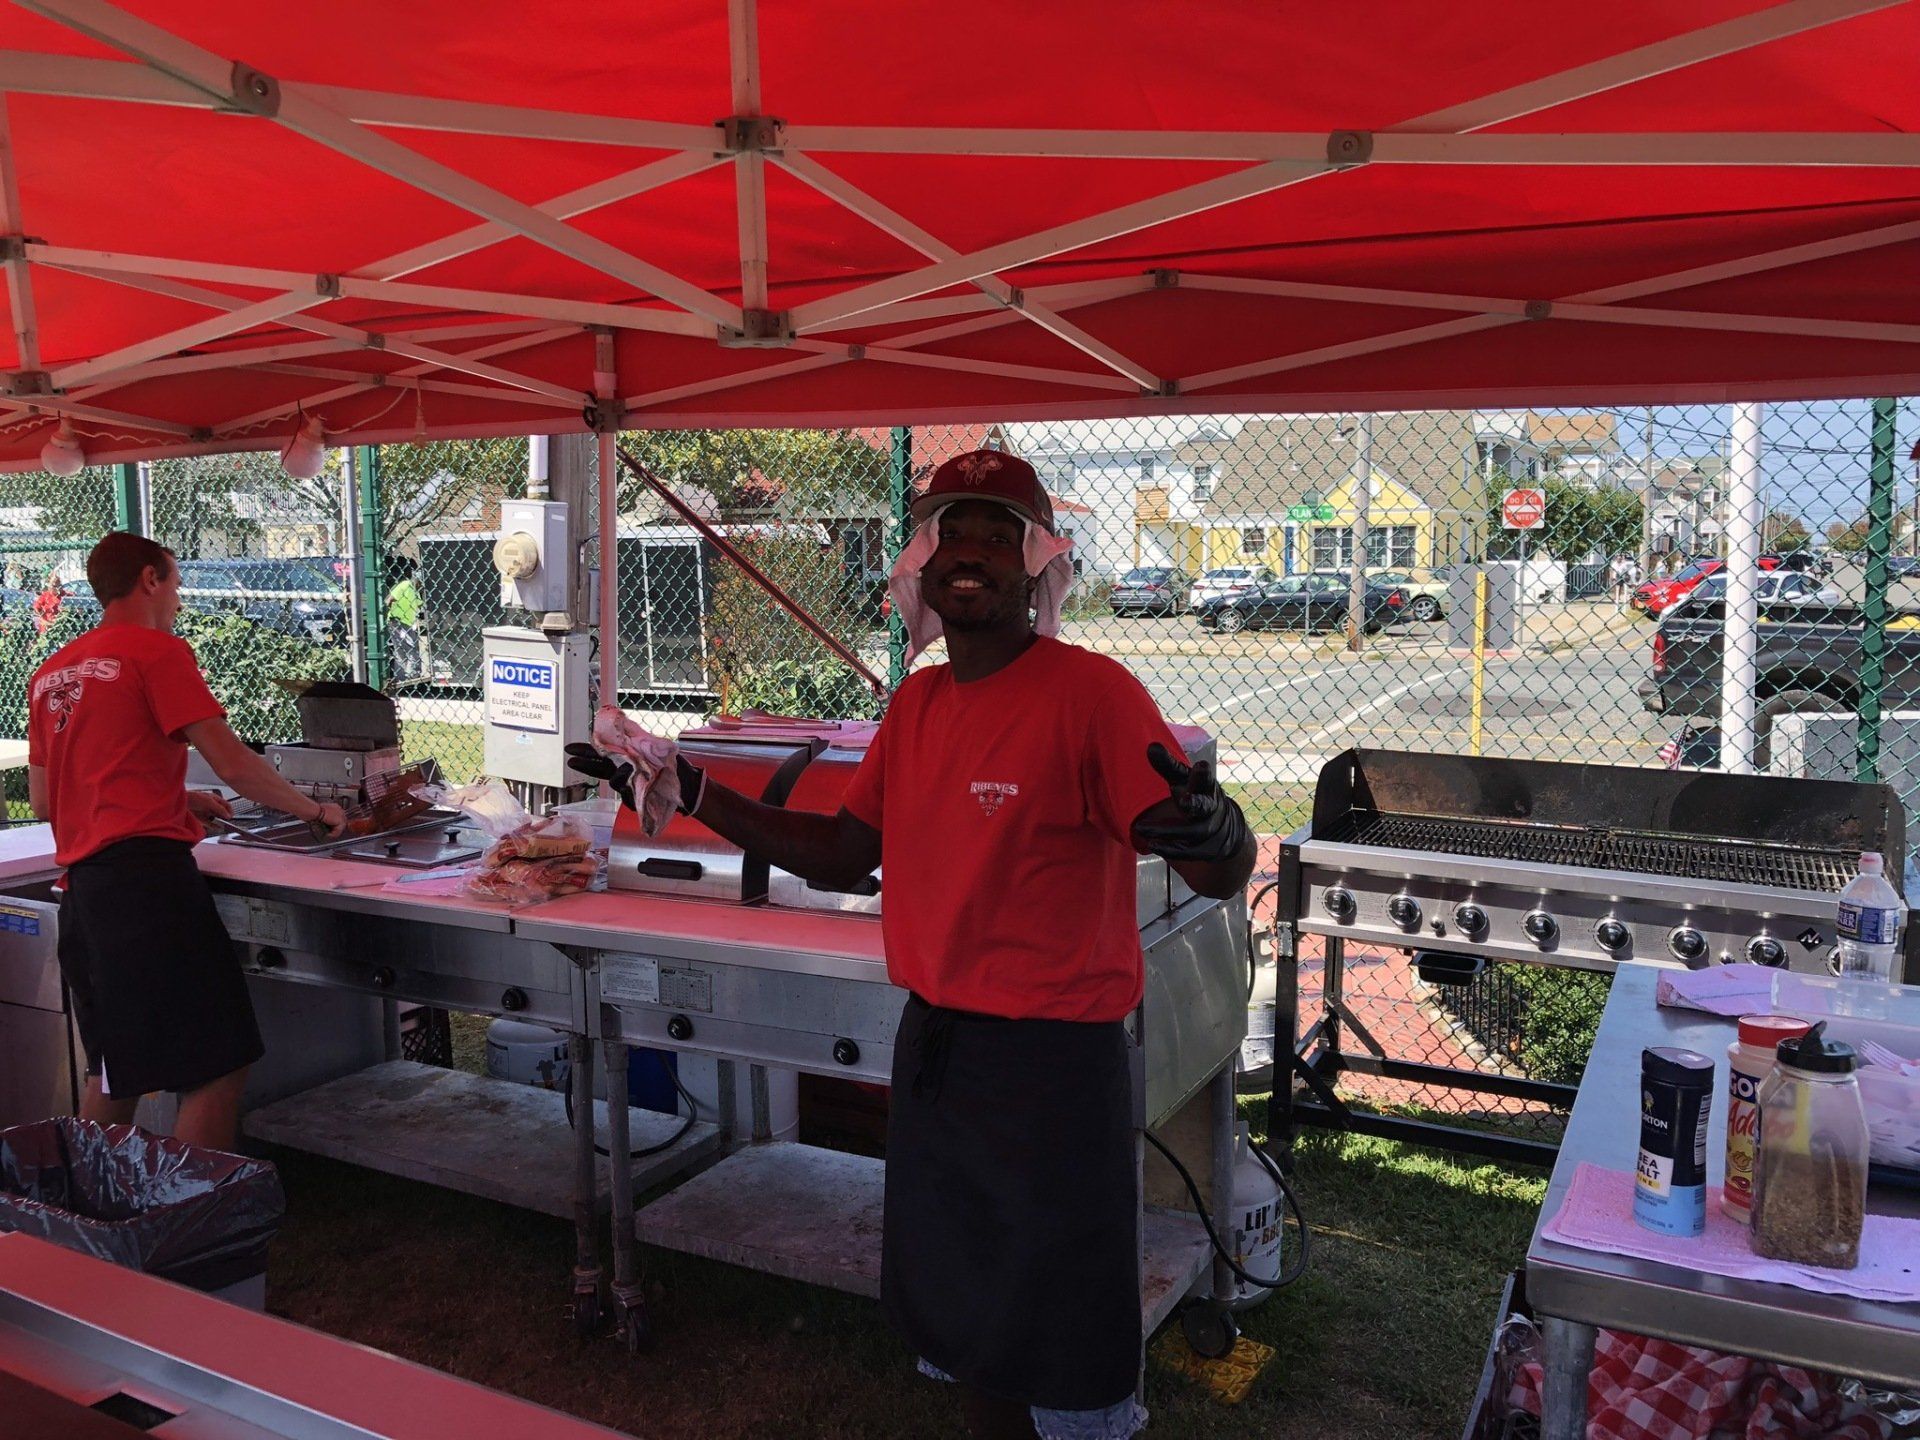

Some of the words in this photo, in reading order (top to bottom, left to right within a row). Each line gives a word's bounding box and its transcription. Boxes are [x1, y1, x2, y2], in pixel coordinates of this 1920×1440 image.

[1287, 508, 1323, 518] TLANC
[494, 664, 551, 685] NOTICE
[513, 691, 530, 699] KEEP
[491, 698, 531, 709] ELECTRICAL
[531, 702, 553, 712] PANEL
[502, 709, 520, 718] AREA
[520, 710, 543, 720] CLEAR
[1730, 1073, 1758, 1098] GO
[1641, 1113, 1668, 1130] RTON
